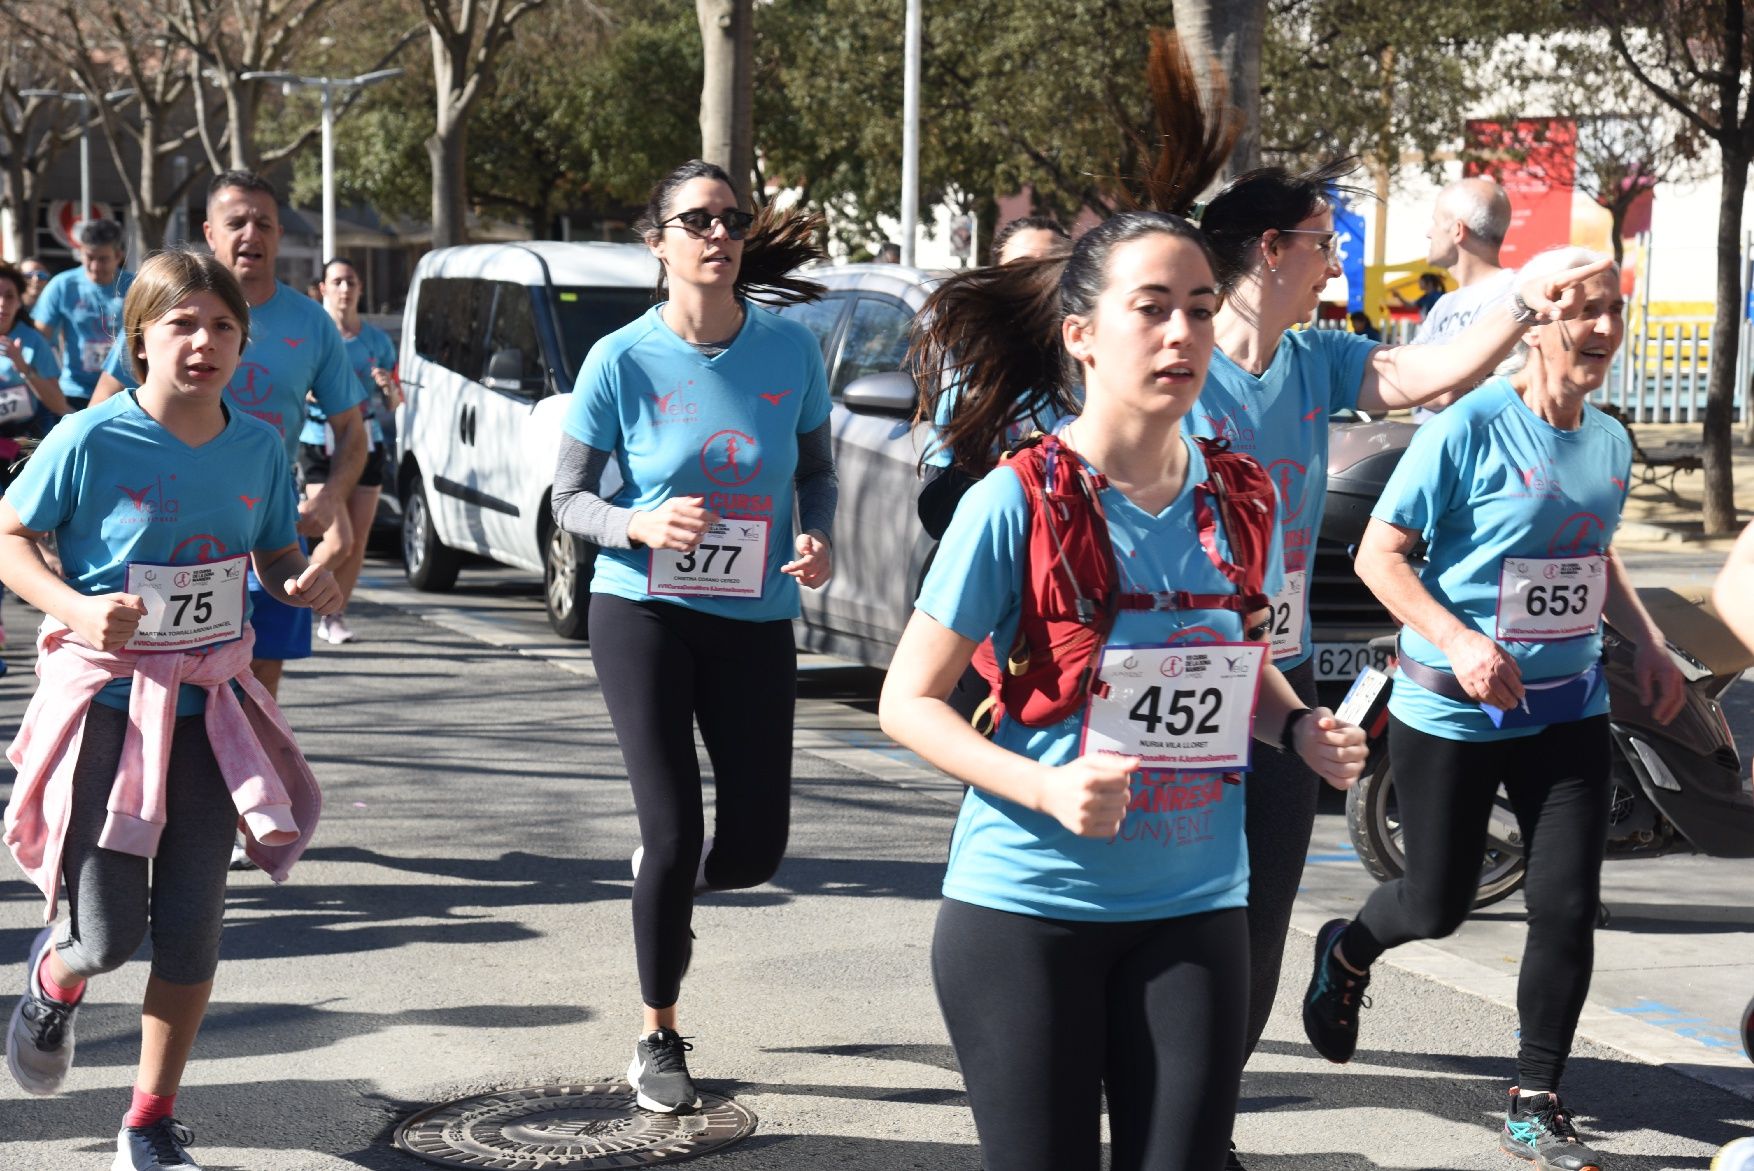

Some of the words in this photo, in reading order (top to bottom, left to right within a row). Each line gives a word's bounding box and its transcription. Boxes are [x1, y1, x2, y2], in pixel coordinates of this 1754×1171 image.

[710, 491, 773, 513] CURSA
[676, 544, 742, 574] 377
[171, 591, 213, 626] 75
[1526, 584, 1588, 617] 653
[1319, 648, 1388, 677] 6208
[1129, 686, 1222, 736] 452
[1166, 741, 1181, 749] VILA
[1182, 740, 1208, 749] LLORET
[1128, 778, 1223, 814] ANRESA
